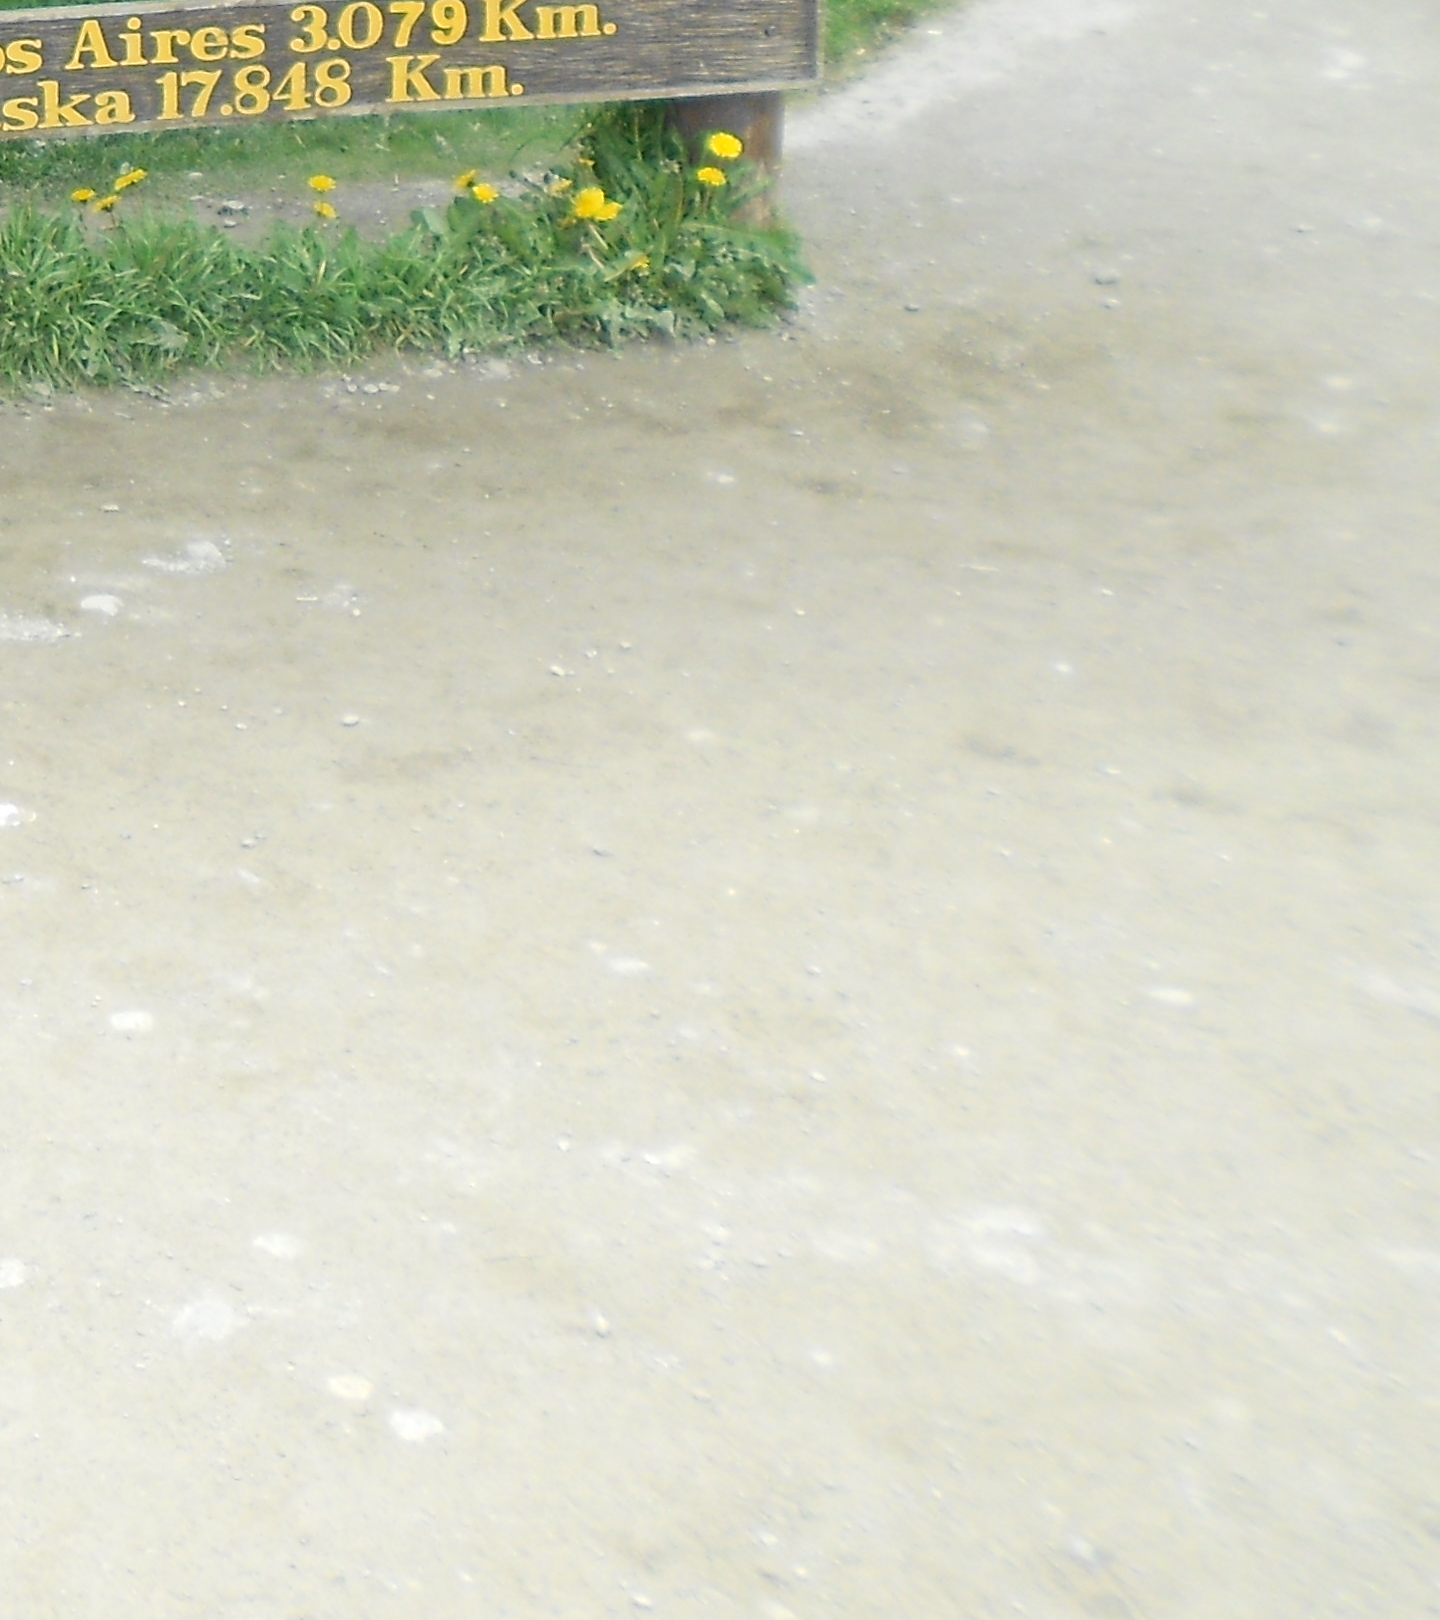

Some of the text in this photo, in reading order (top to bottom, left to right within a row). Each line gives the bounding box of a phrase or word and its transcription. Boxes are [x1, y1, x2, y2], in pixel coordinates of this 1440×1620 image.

[67, 19, 267, 70] Aires
[154, 58, 352, 121] 17.848
[386, 56, 524, 104] Km.
